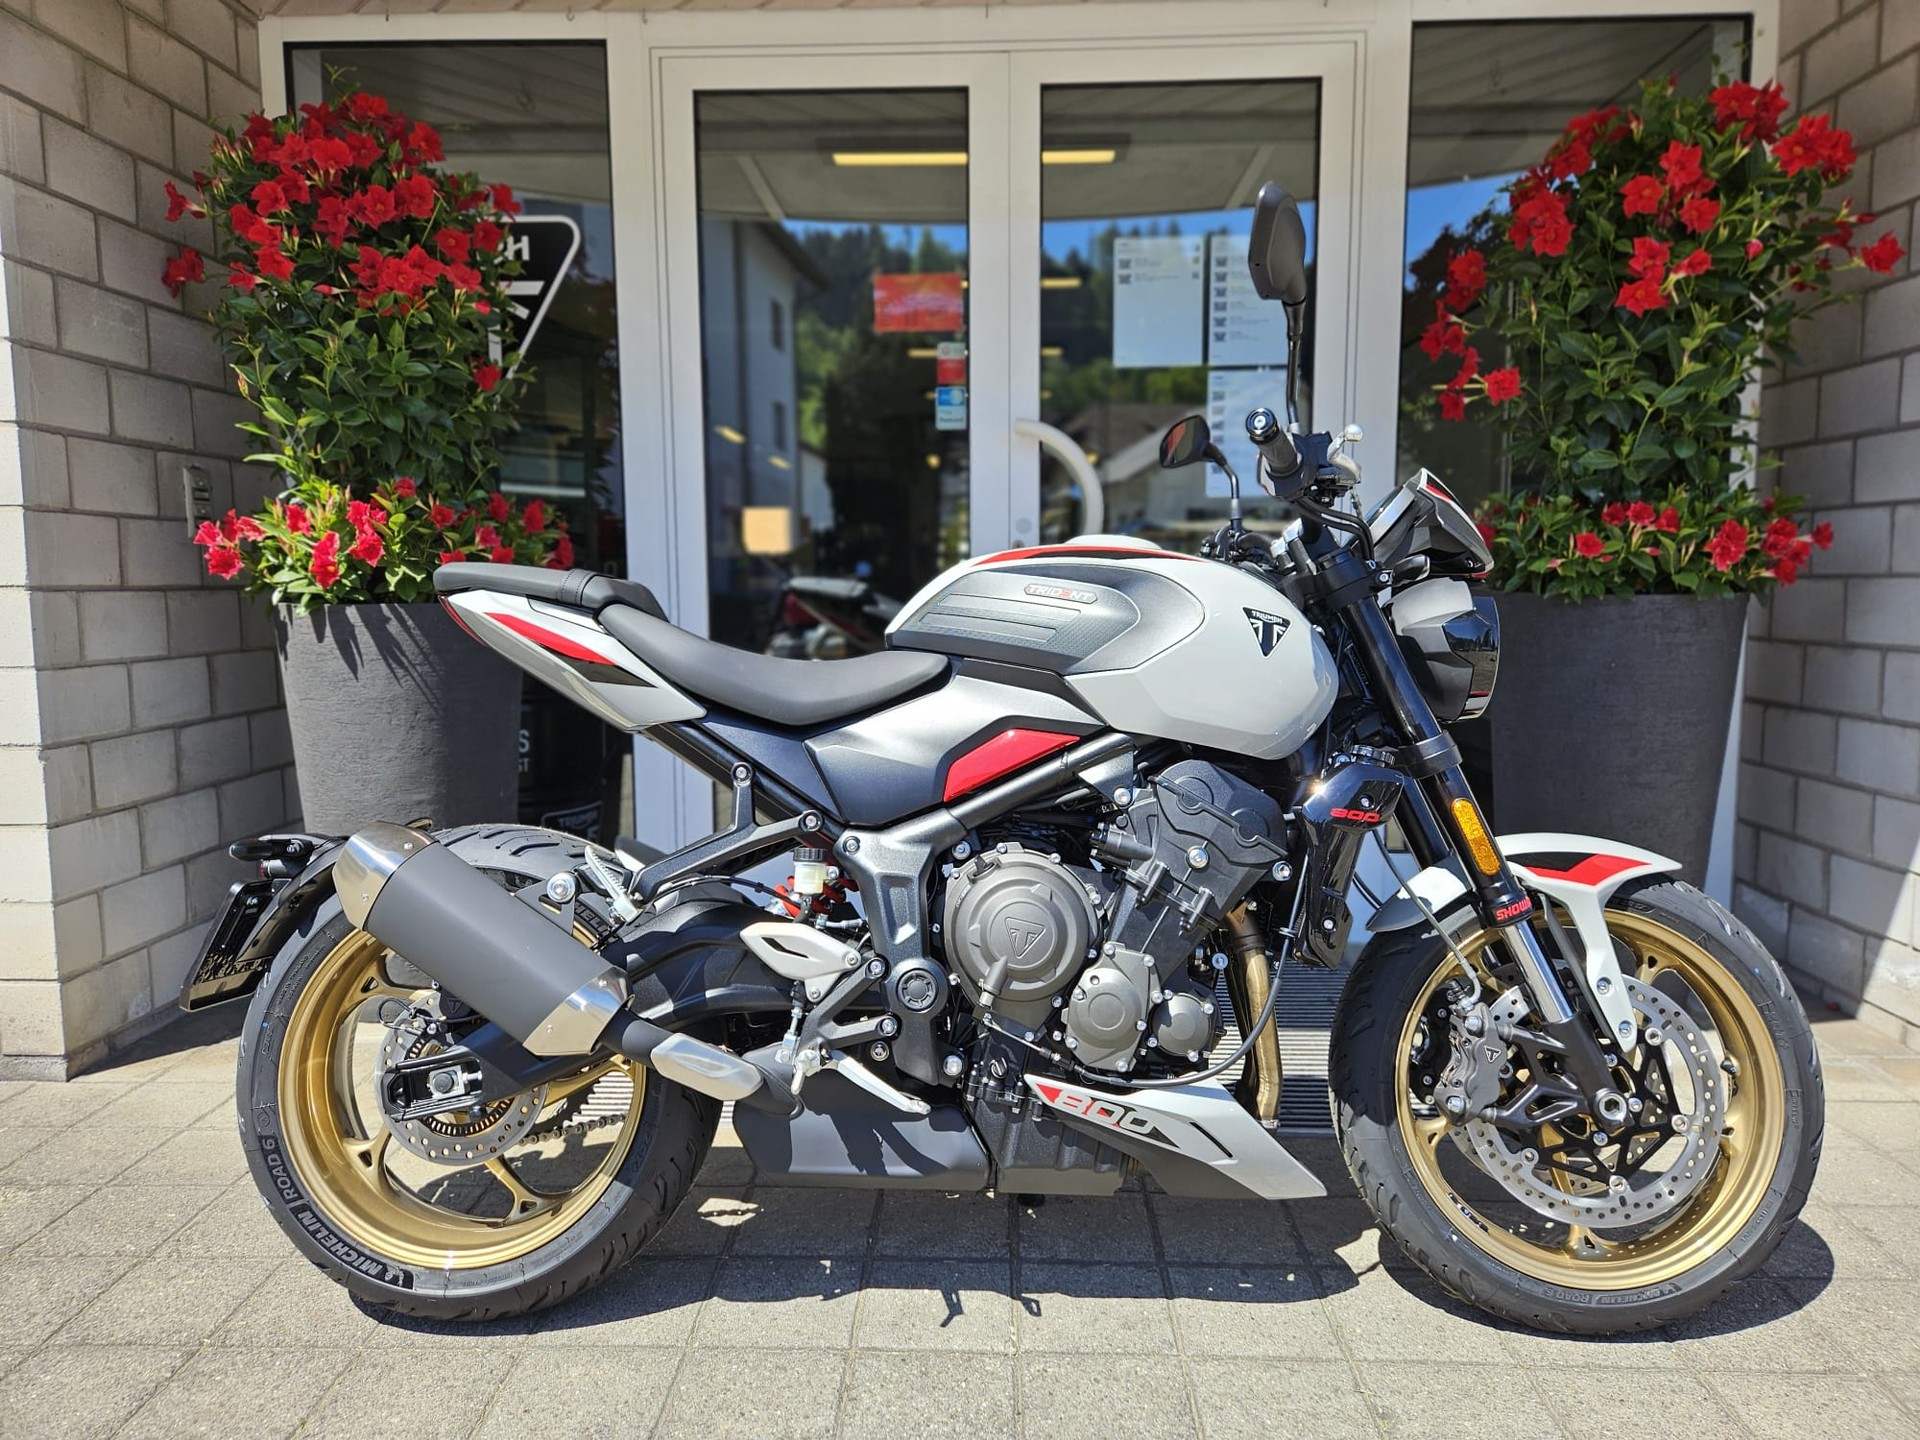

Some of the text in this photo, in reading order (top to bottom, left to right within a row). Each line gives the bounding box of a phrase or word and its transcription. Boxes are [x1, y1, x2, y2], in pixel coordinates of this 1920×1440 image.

[1251, 610, 1283, 624] TRIUMPH
[1054, 1090, 1155, 1134] 800
[262, 1137, 384, 1276] MICHELIN ROAD 6
[1556, 1290, 1590, 1304] ROAD
